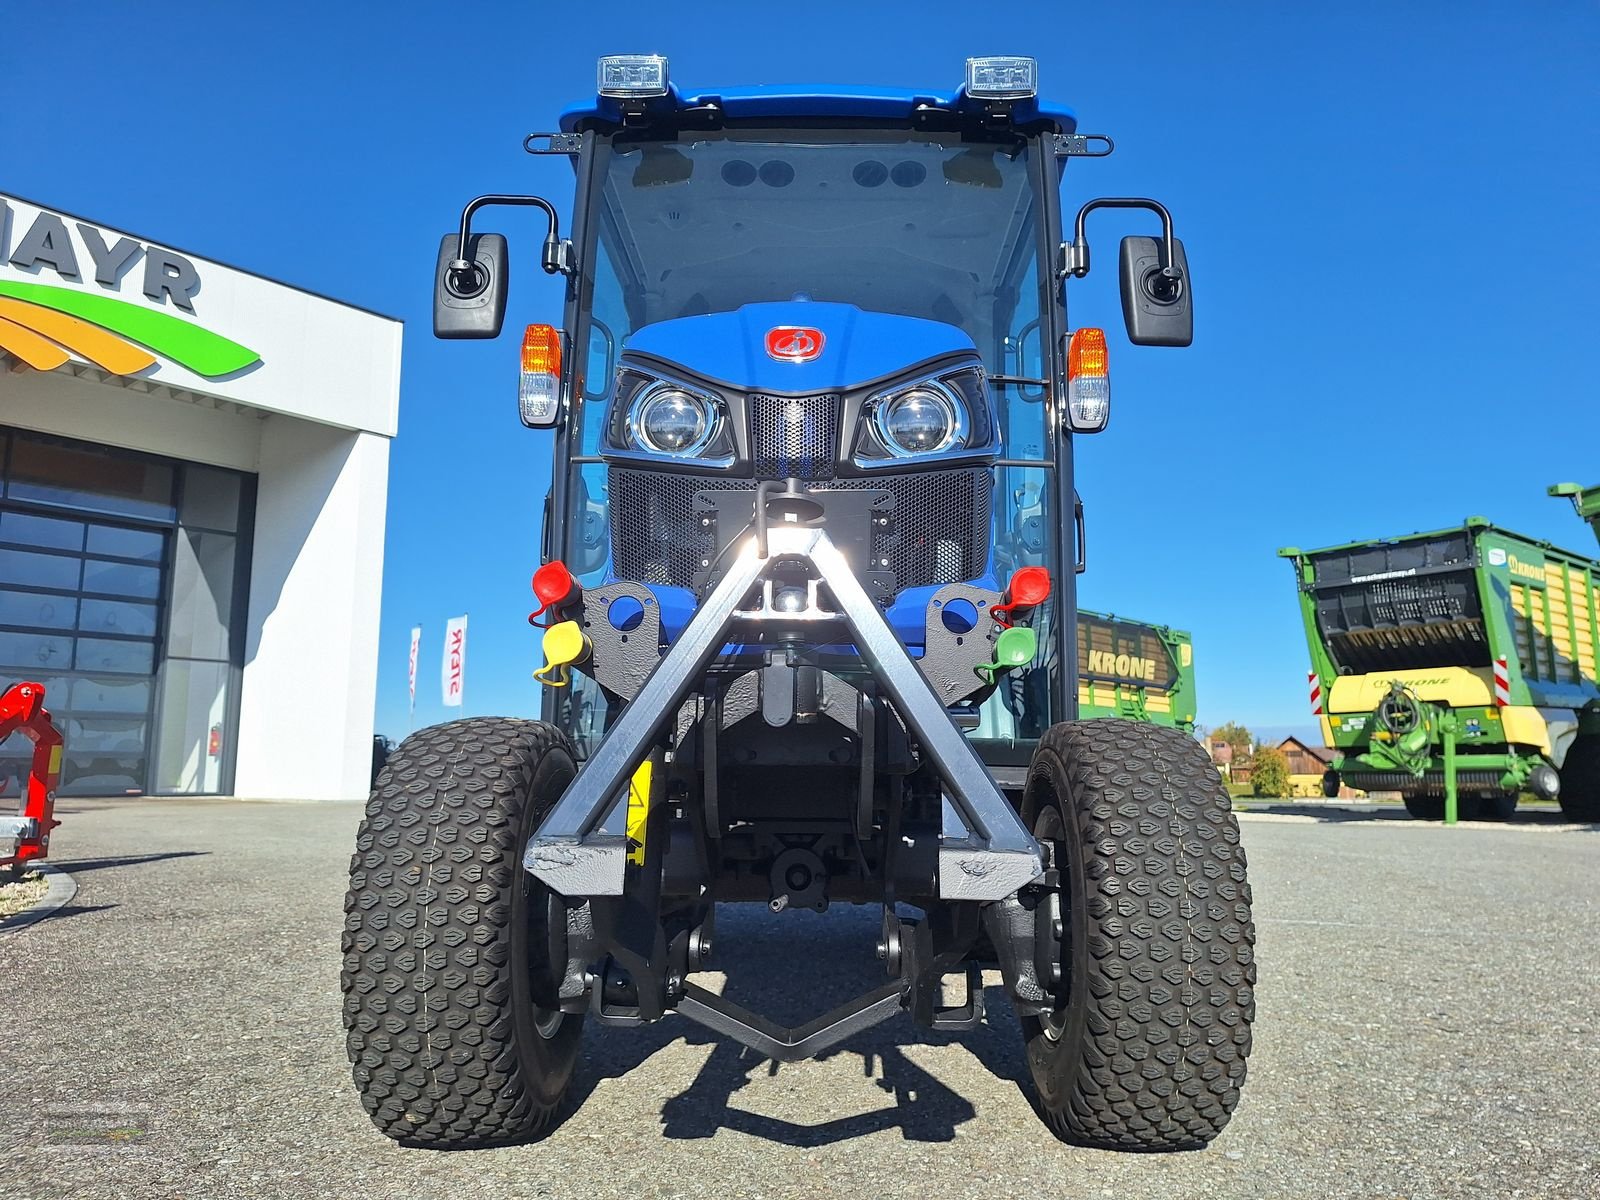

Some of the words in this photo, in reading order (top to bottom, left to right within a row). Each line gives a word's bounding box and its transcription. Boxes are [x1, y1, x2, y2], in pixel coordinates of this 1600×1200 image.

[0, 198, 197, 311] AYR
[1087, 649, 1156, 681] KRONE
[1395, 677, 1451, 688] RONE
